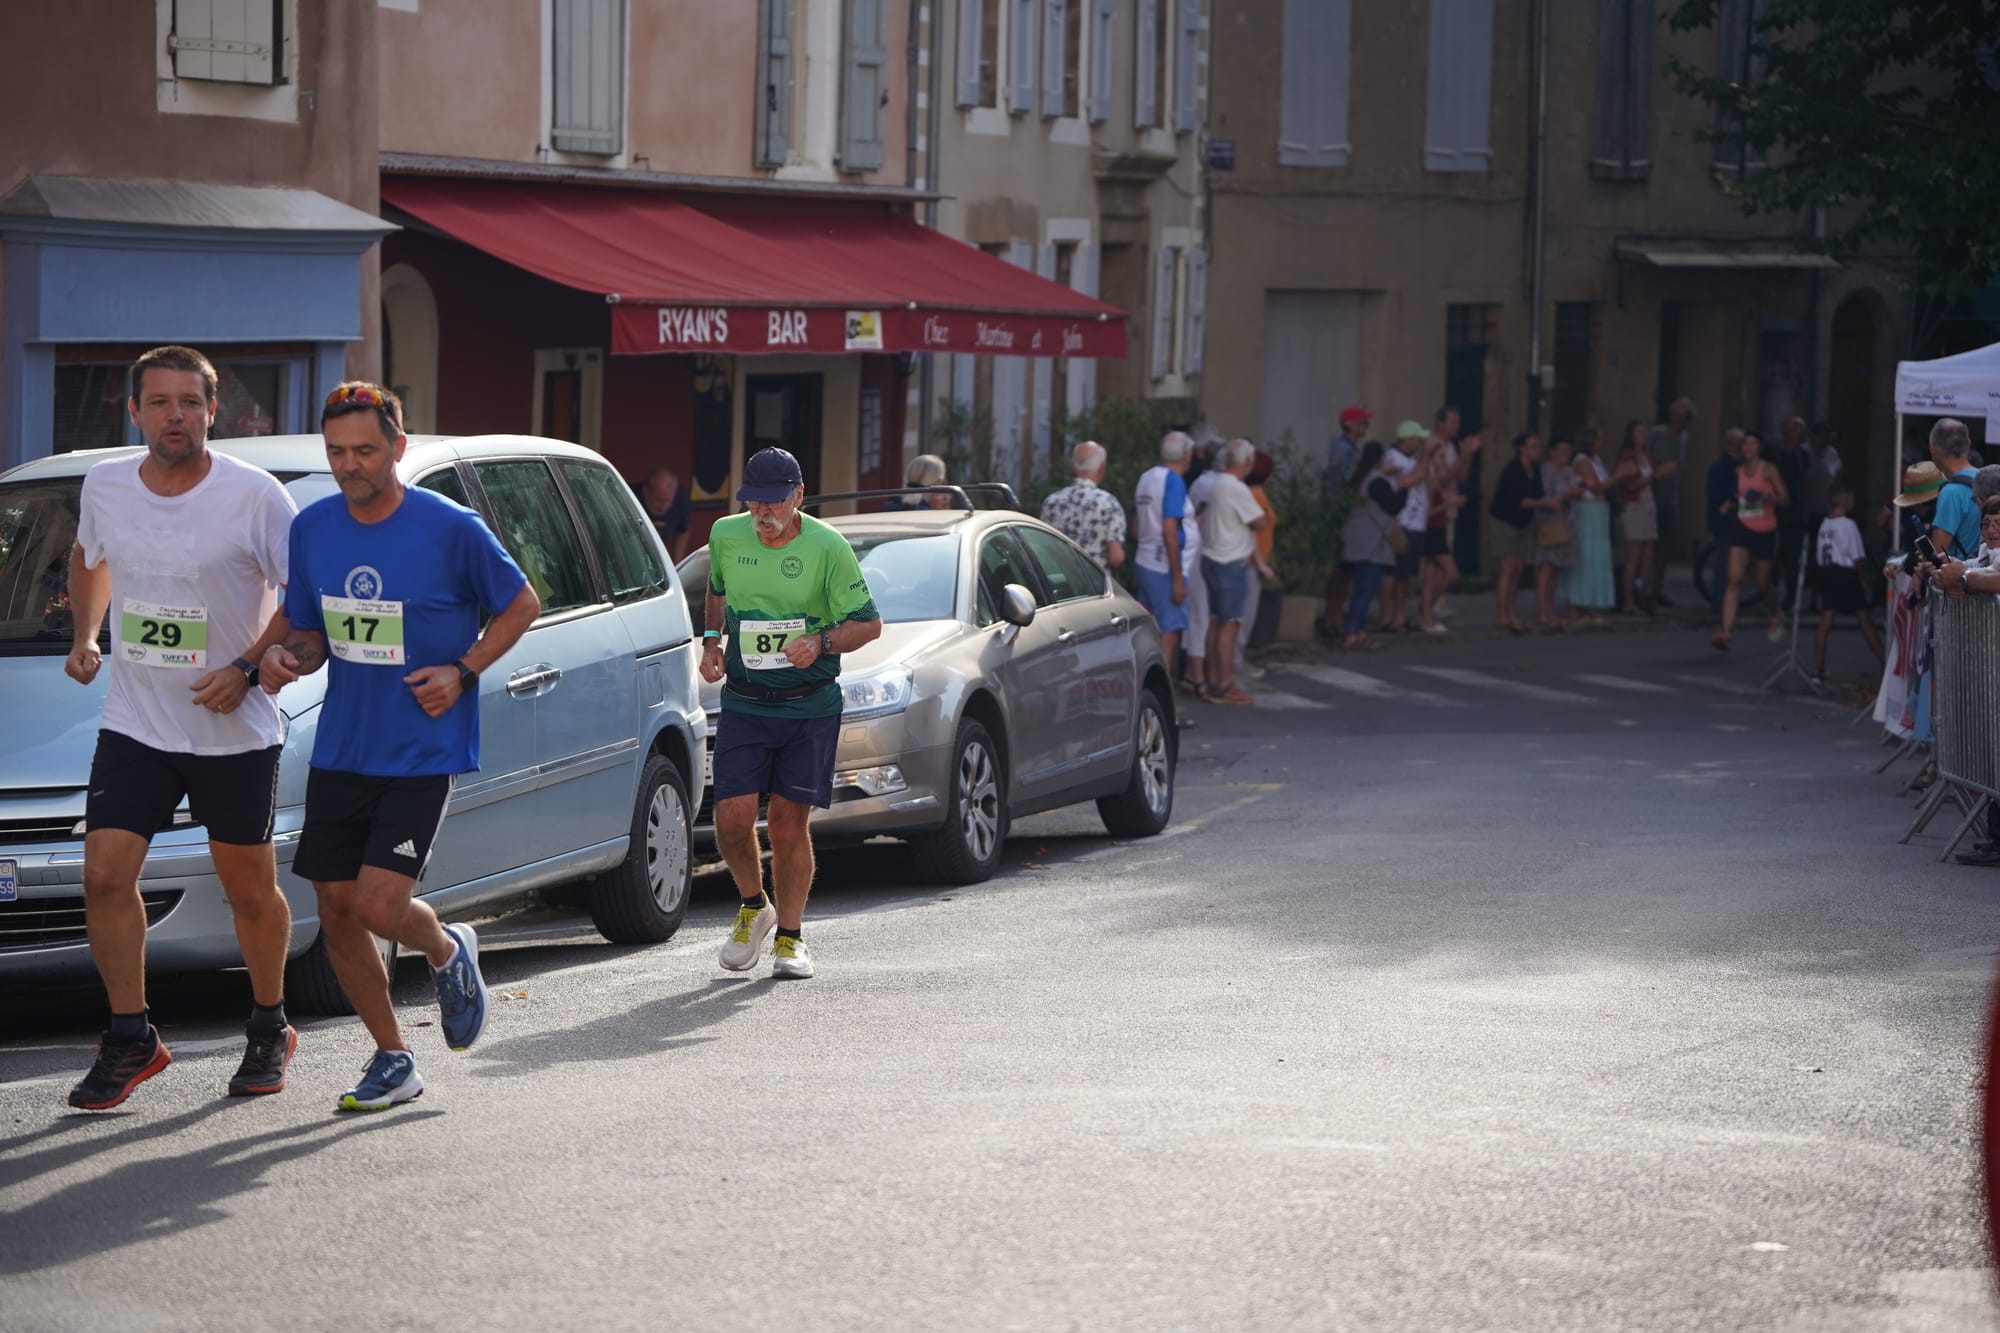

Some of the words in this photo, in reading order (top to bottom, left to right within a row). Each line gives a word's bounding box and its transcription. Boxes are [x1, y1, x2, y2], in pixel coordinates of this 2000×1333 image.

[658, 308, 729, 344] RYAN'S
[767, 310, 808, 345] BAR
[140, 620, 182, 647] 29
[342, 616, 379, 642] 17
[756, 633, 788, 653] 87
[0, 881, 14, 894] 59
